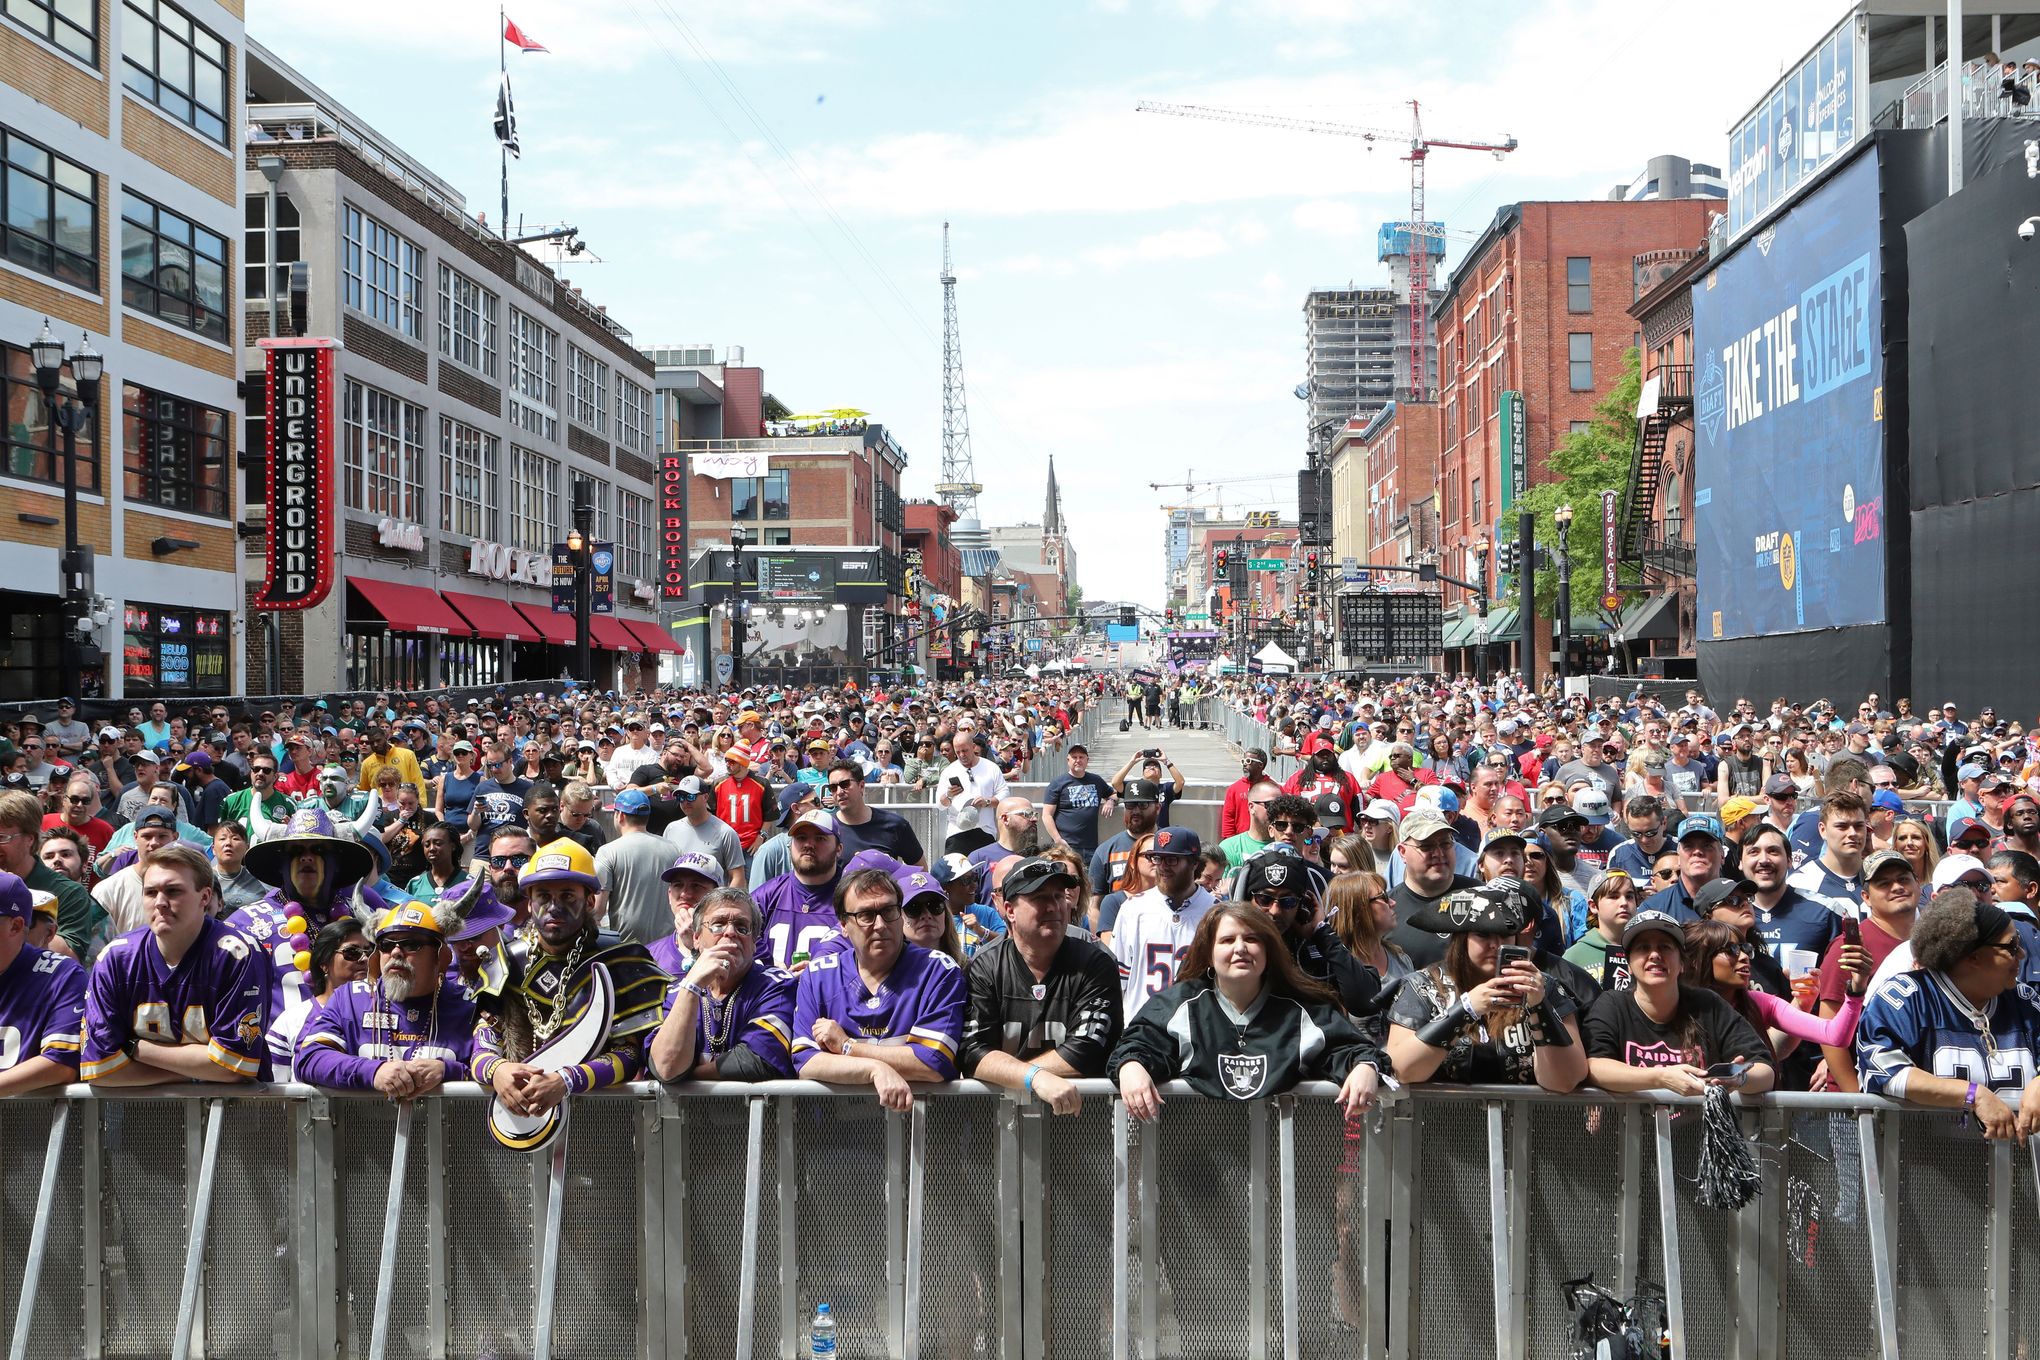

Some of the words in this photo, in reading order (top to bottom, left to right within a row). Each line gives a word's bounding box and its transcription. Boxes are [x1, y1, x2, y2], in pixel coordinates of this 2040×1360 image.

[1728, 144, 1767, 200] verizon
[1723, 327, 1763, 431] TAKE
[1764, 304, 1800, 412] THE
[1805, 267, 1865, 391] STAGE
[1701, 388, 1723, 416] DRAFT
[286, 353, 306, 593] UNDERGROUND
[664, 457, 682, 509] ROCK
[1606, 495, 1614, 523] Hard
[1607, 528, 1615, 560] Rock
[1755, 531, 1779, 553] DRAFT
[557, 555, 568, 563] THE
[665, 517, 683, 596] BOTTOM
[842, 561, 868, 570] ESPN
[553, 566, 574, 574] FUTURE
[1607, 563, 1615, 594] Cafe
[553, 577, 559, 586] IS
[559, 577, 573, 586] NOW
[160, 643, 188, 656] HELLO
[160, 655, 190, 671] GOOD
[208, 654, 223, 675] BEER
[728, 794, 750, 823] 11
[1487, 827, 1517, 841] SMAS
[1453, 902, 1468, 916] AL
[1515, 1046, 1527, 1054] 63
[1224, 1058, 1262, 1067] RAIDERS
[1933, 1046, 2037, 1094] 22
